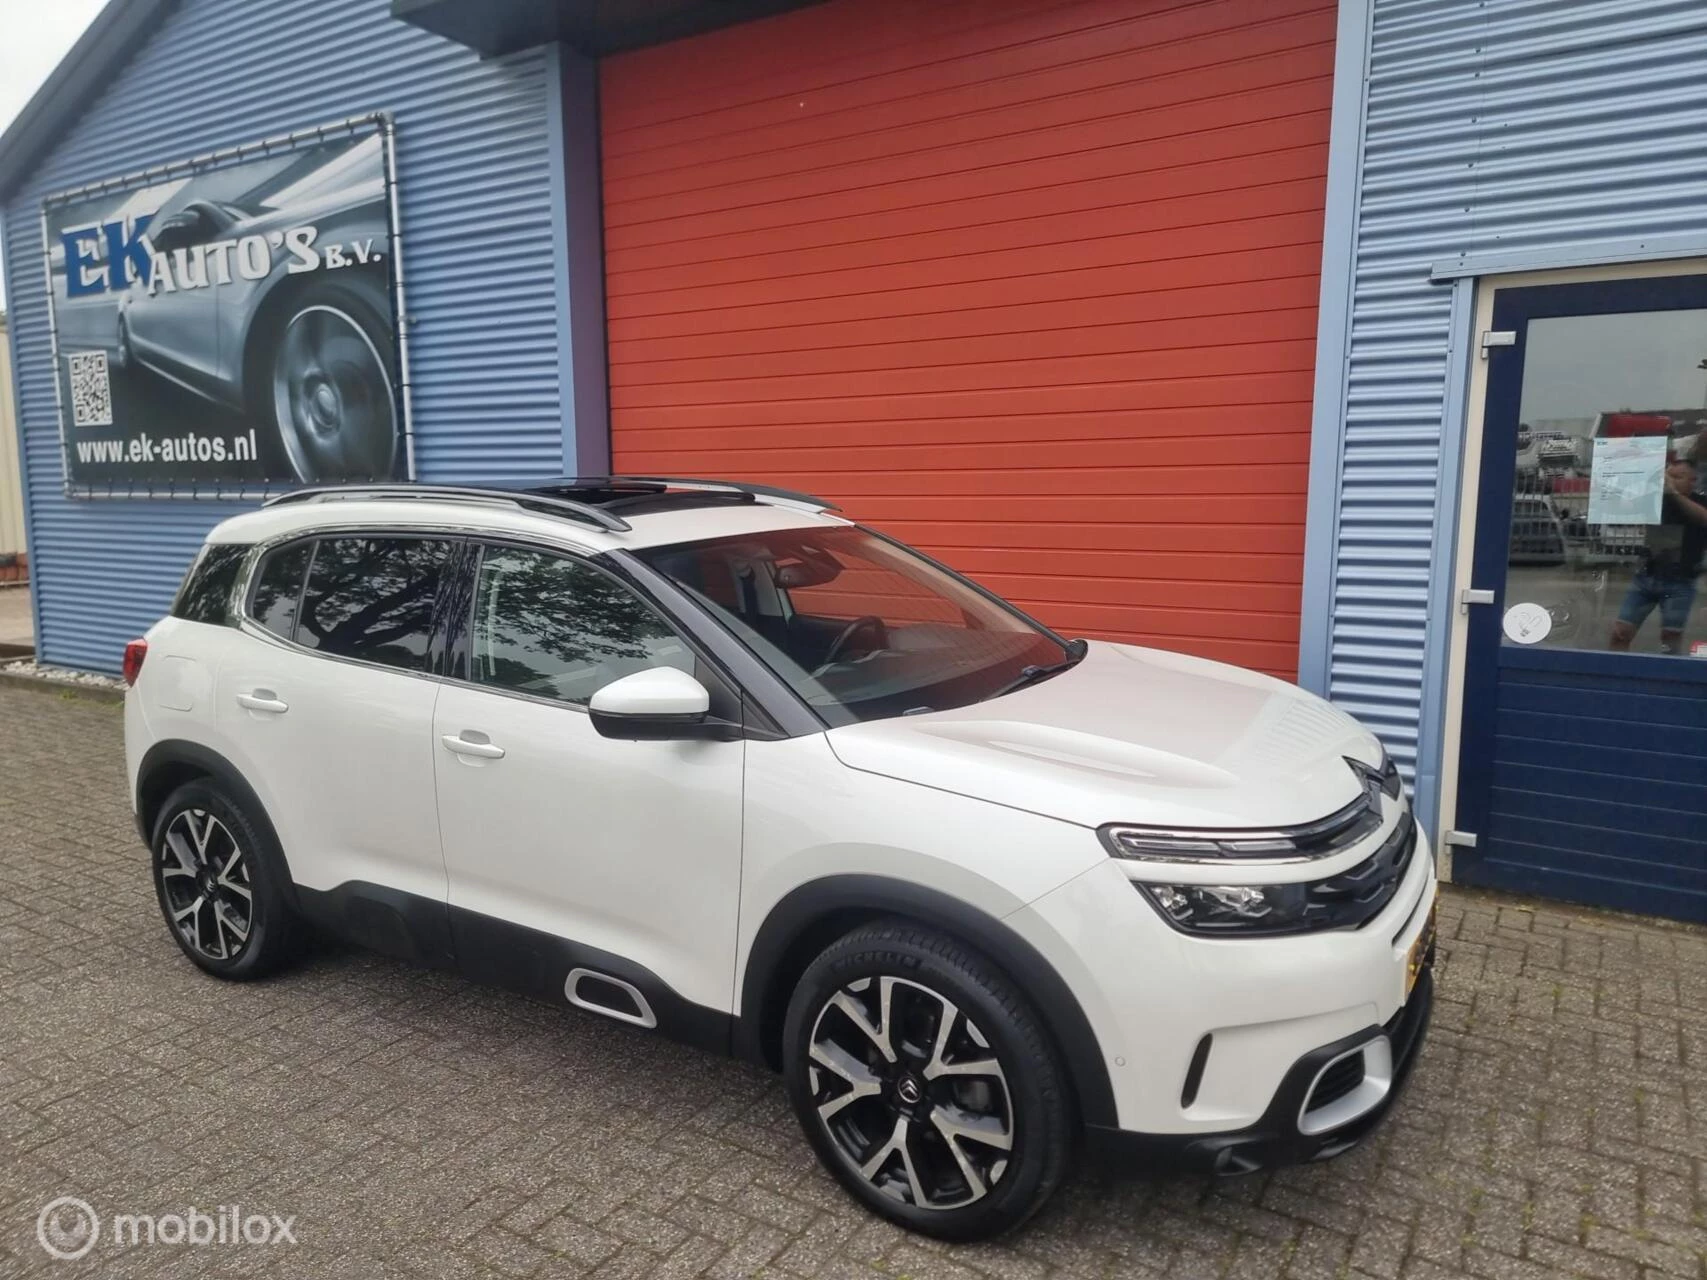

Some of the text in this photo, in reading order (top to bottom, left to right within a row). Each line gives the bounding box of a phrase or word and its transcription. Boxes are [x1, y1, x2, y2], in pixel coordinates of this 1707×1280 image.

[62, 212, 382, 298] EK AUTO'S B.V.
[77, 429, 257, 463] www.ek-autos.nl
